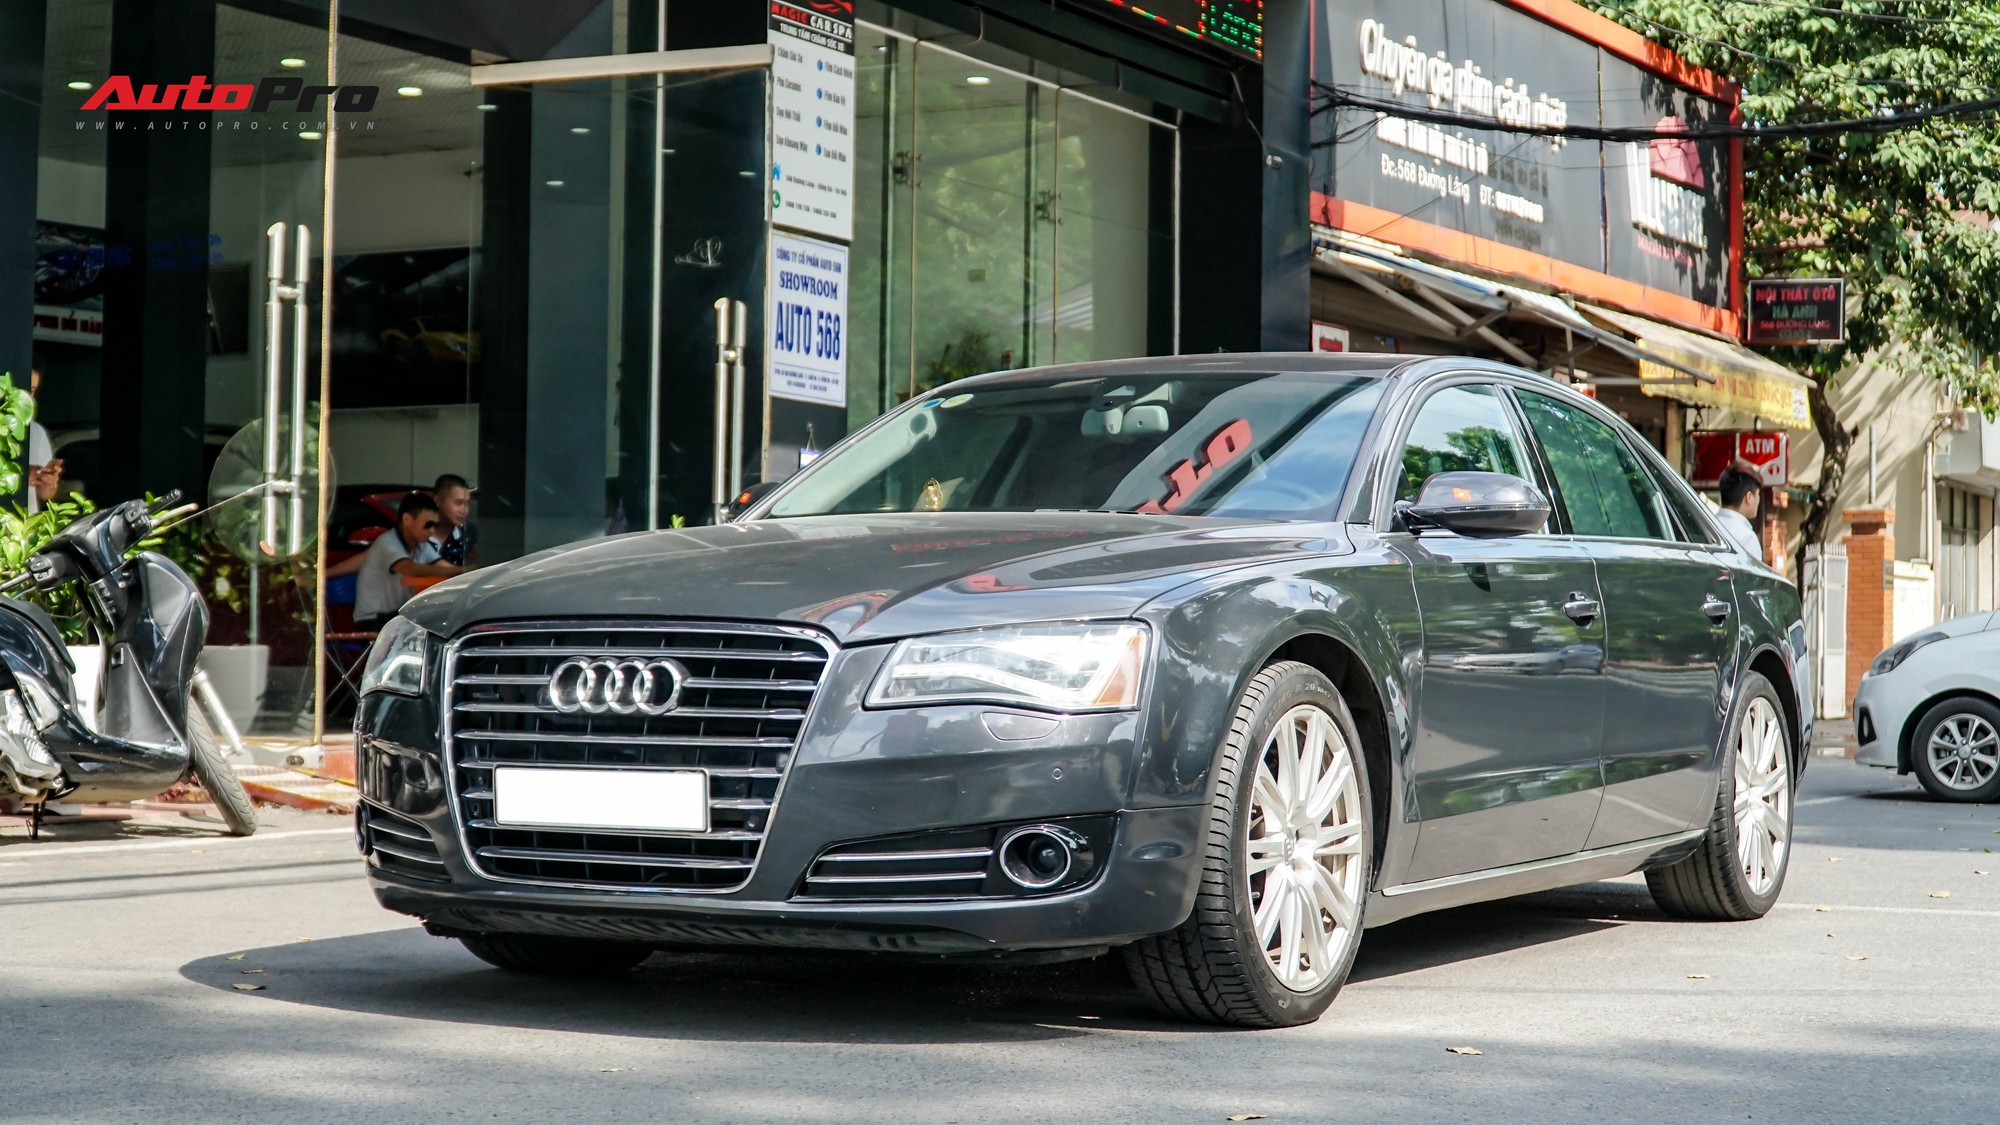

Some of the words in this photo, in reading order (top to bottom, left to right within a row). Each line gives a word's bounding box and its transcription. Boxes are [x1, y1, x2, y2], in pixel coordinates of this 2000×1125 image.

[771, 3, 808, 24] MAGIC
[810, 15, 832, 32] CAR
[833, 22, 853, 40] SPA
[1360, 18, 1427, 98] Chuyên
[1427, 50, 1454, 109] gia
[1454, 59, 1494, 116] phim
[1494, 77, 1532, 128] cách
[776, 246, 790, 263] CÔNG
[791, 250, 798, 263] TY
[778, 271, 839, 300] SHOWROOM
[1755, 286, 1776, 305] NỘI
[1780, 285, 1809, 302] THẤT
[1772, 304, 1788, 319] HÀ
[1792, 305, 1818, 319] ANH
[774, 300, 812, 356] AUTO
[816, 310, 841, 361] 568
[1760, 319, 1775, 329] 568
[1745, 438, 1775, 454] ATM
